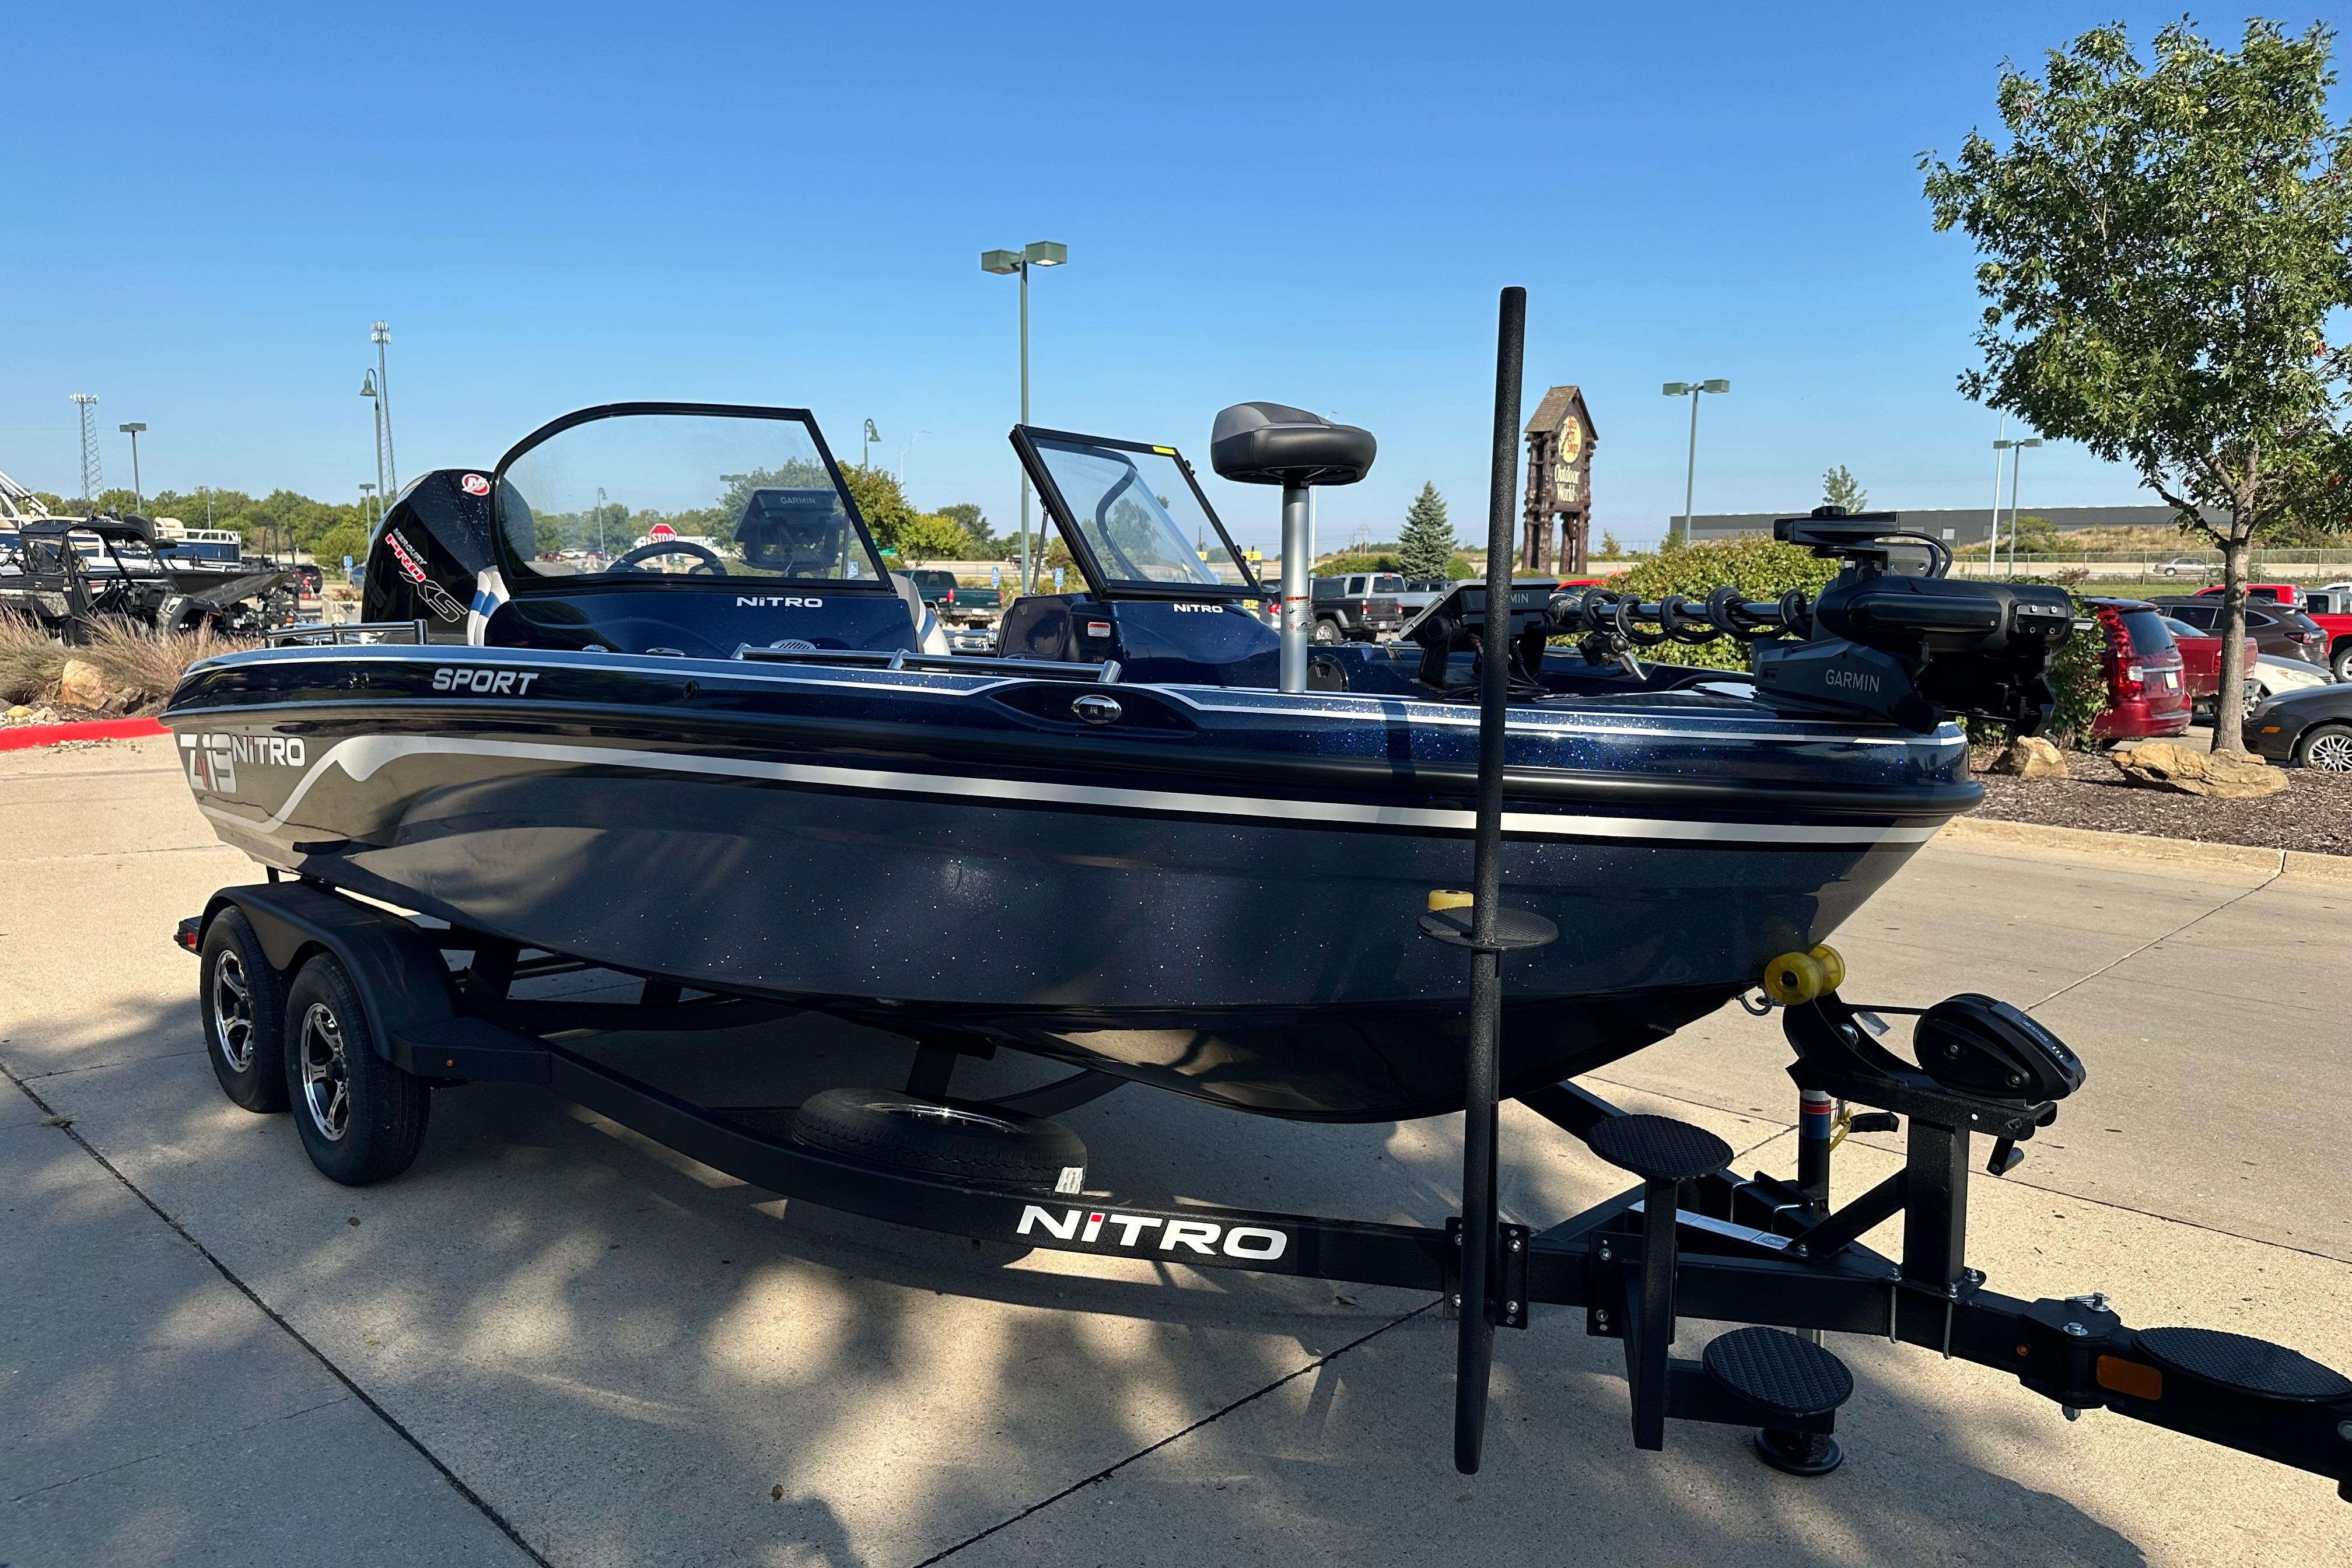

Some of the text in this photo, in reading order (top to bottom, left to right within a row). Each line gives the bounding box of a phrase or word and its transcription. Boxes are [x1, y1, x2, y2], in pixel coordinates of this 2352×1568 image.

[1554, 464, 1580, 484] Outdoor
[780, 496, 817, 505] GARMIN
[1556, 483, 1576, 502] World
[393, 527, 428, 565] MERCURY
[651, 533, 675, 542] STOP
[385, 533, 426, 583] PRO
[398, 561, 469, 623] XS
[1511, 593, 1529, 604] MIN
[432, 667, 540, 695] SPORT
[1825, 668, 1880, 693] GARMIN
